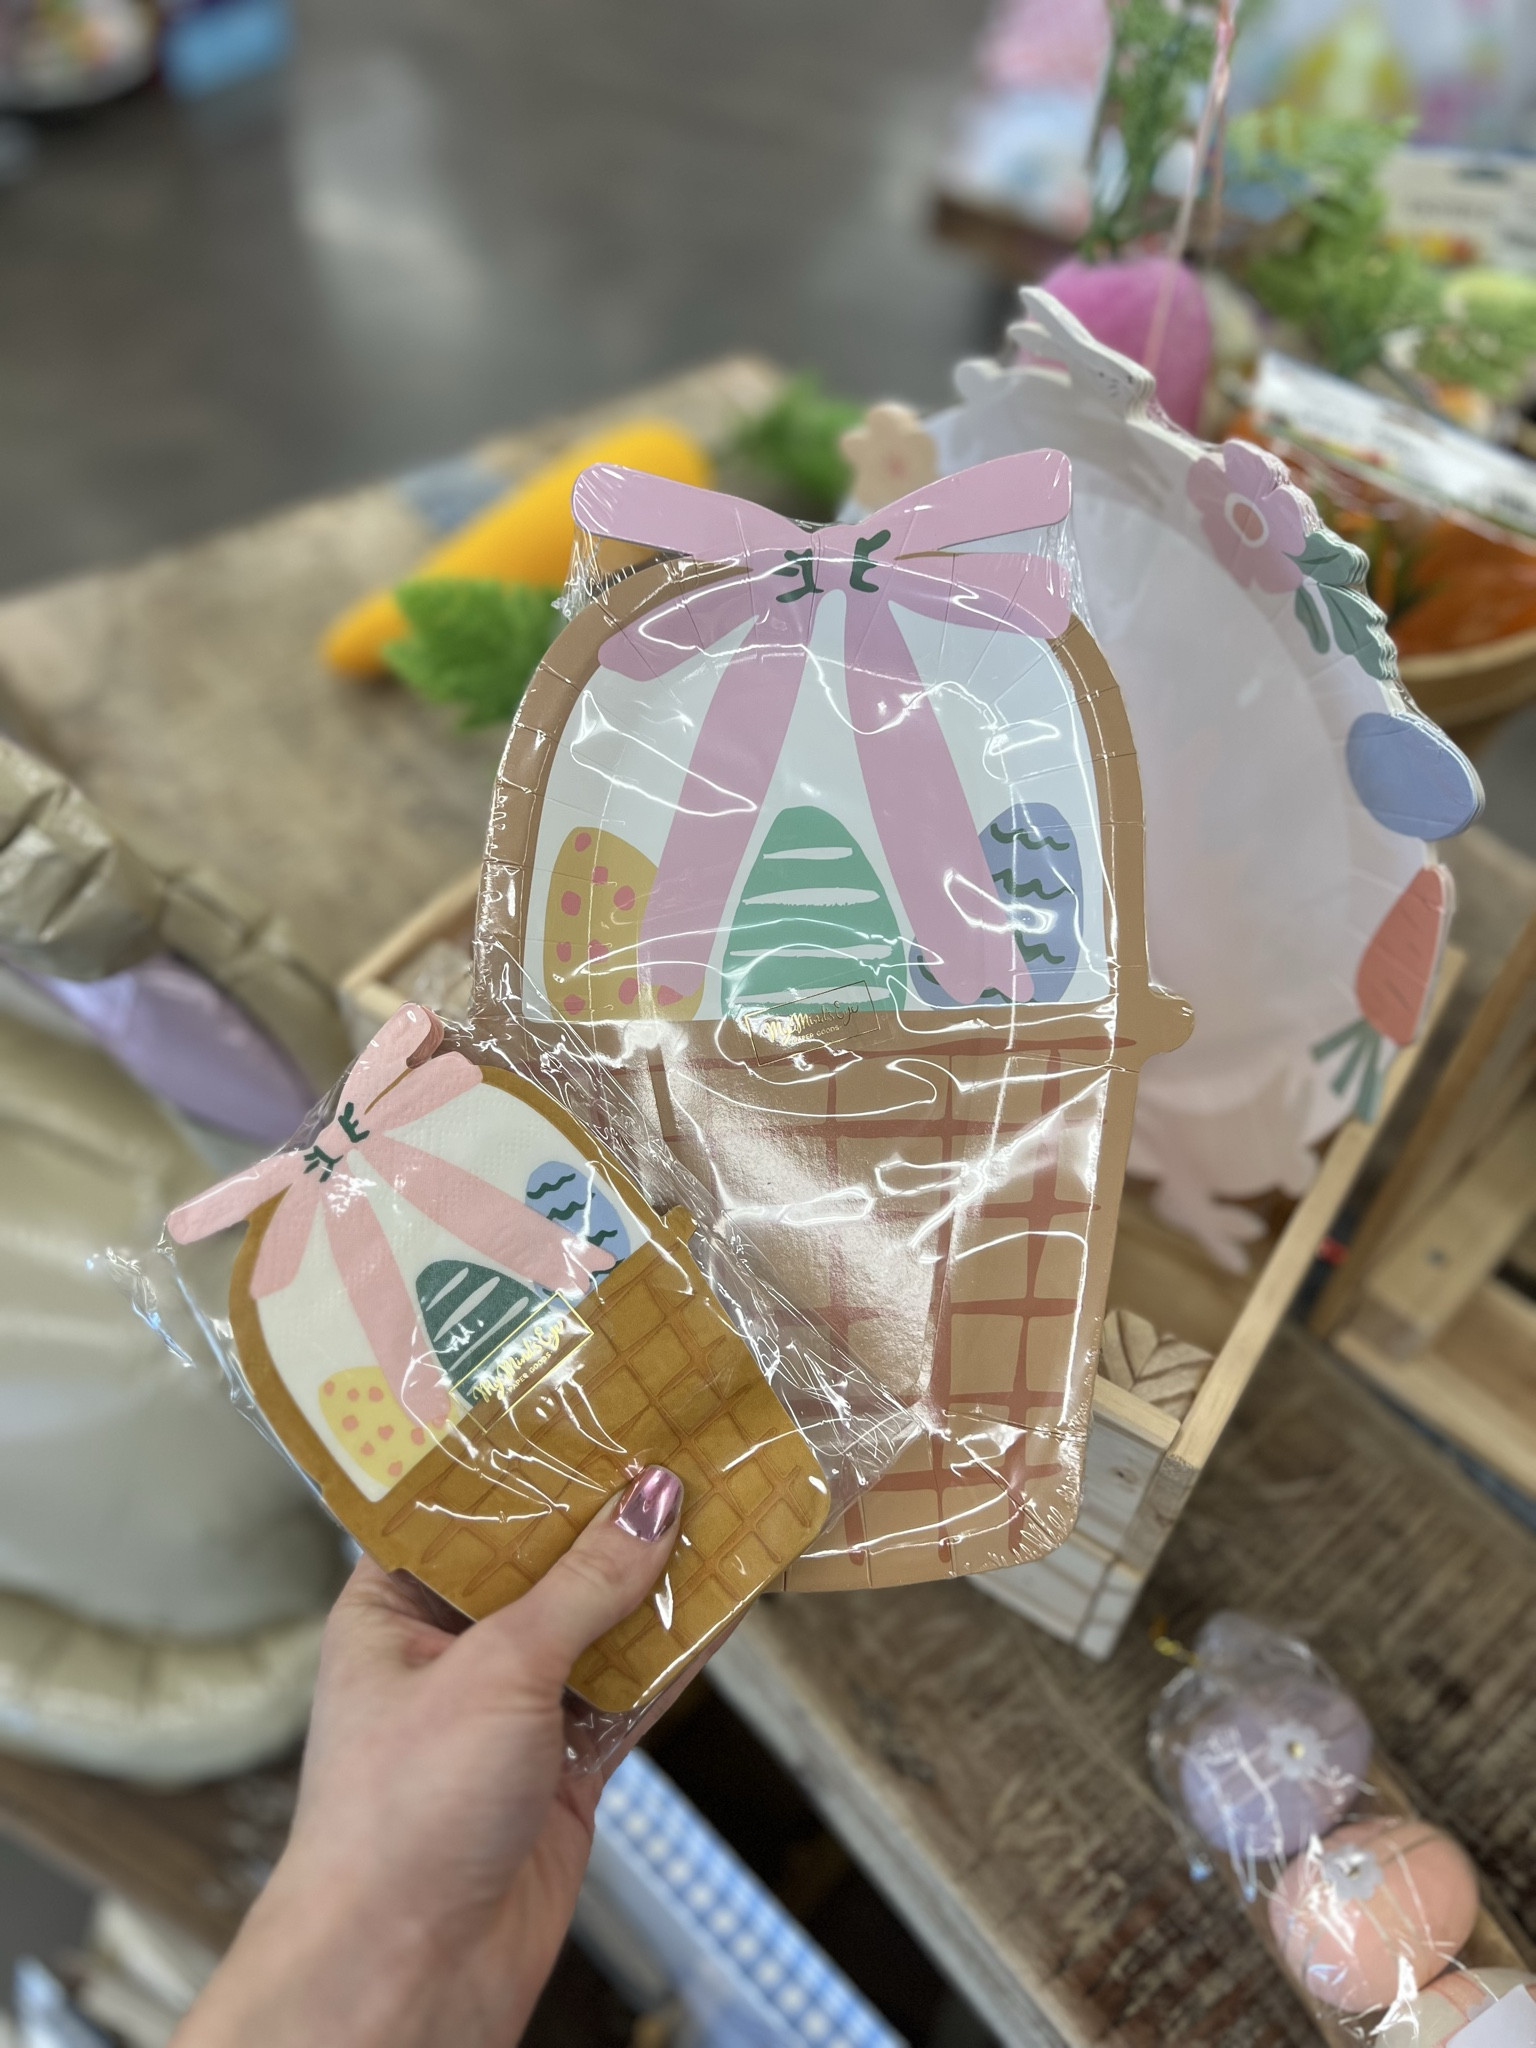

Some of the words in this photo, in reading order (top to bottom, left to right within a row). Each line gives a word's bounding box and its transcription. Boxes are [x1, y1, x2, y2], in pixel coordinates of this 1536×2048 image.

[816, 1024, 840, 1037] GOODS
[833, 1000, 860, 1027] Eye
[472, 1376, 505, 1404] My
[533, 1319, 565, 1352] Eye
[507, 1371, 530, 1394] PAPER
[529, 1351, 552, 1374] GOODS
